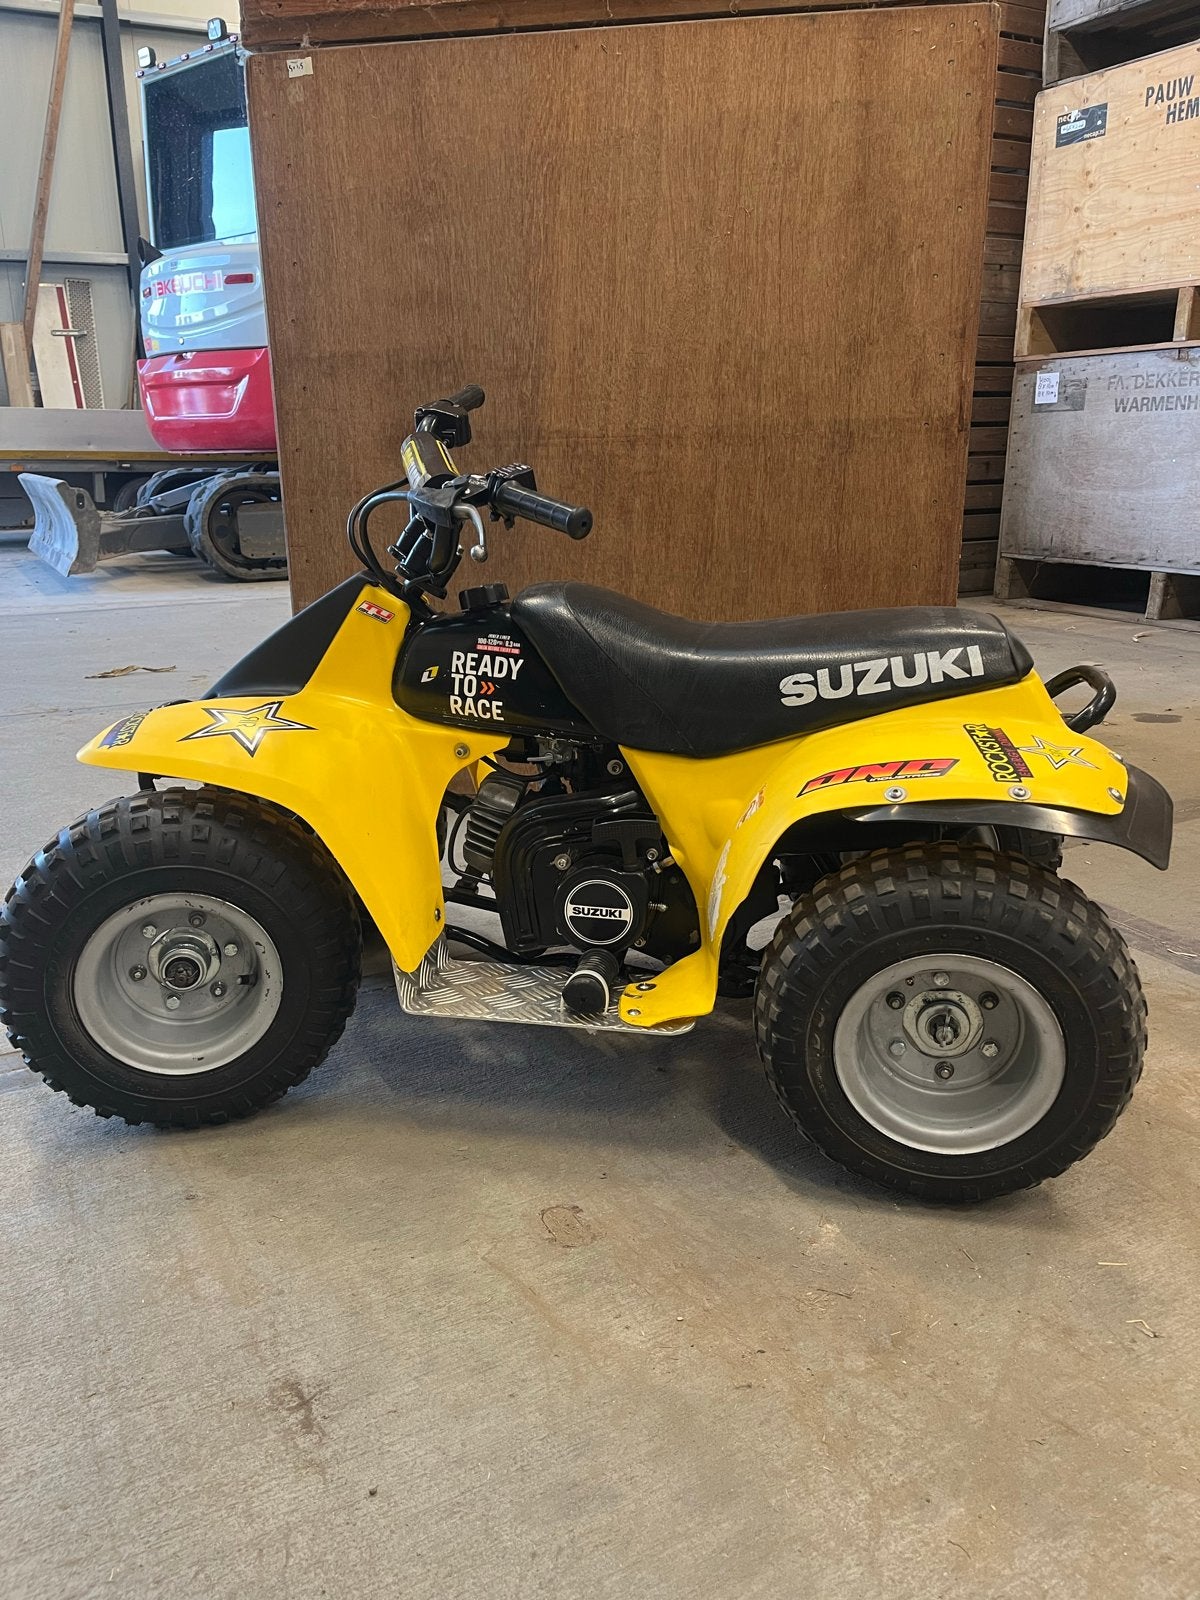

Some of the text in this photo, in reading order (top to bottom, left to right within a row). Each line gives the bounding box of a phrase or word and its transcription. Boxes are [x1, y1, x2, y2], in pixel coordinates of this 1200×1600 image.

[1145, 75, 1195, 108] PAUW
[1165, 96, 1200, 125] HEM
[1133, 371, 1200, 389] DEKKER
[451, 651, 524, 680] READY
[779, 645, 985, 707] SUZUKI
[451, 673, 477, 697] TO
[449, 695, 505, 721] RACE
[572, 906, 622, 918] SUZUKI
